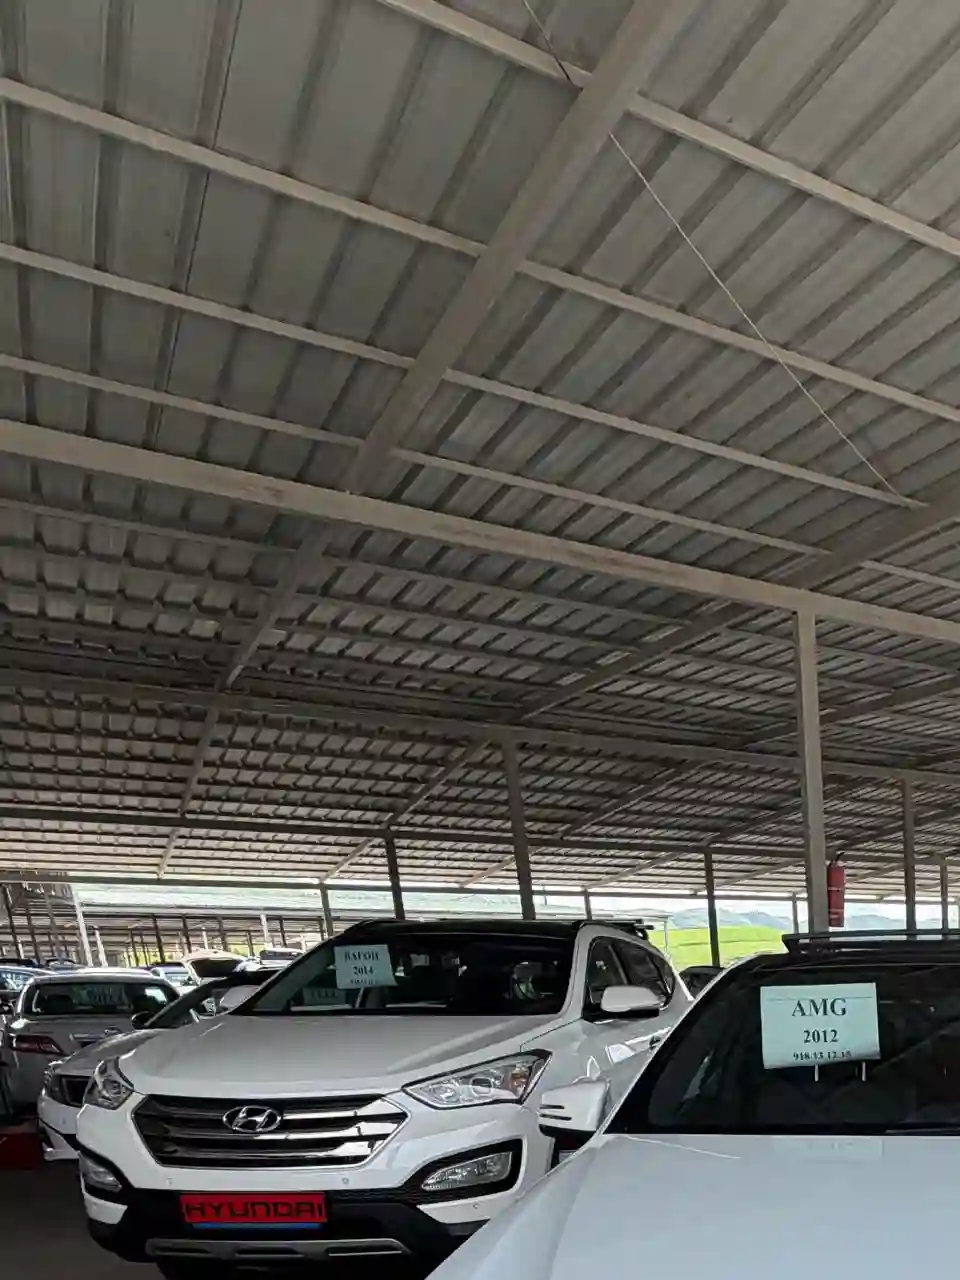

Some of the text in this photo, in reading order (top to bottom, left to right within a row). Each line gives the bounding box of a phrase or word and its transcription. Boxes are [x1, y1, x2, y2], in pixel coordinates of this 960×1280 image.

[791, 998, 847, 1017] AMG
[803, 1029, 839, 1044] 2012
[184, 1202, 324, 1219] HYUNDAI
